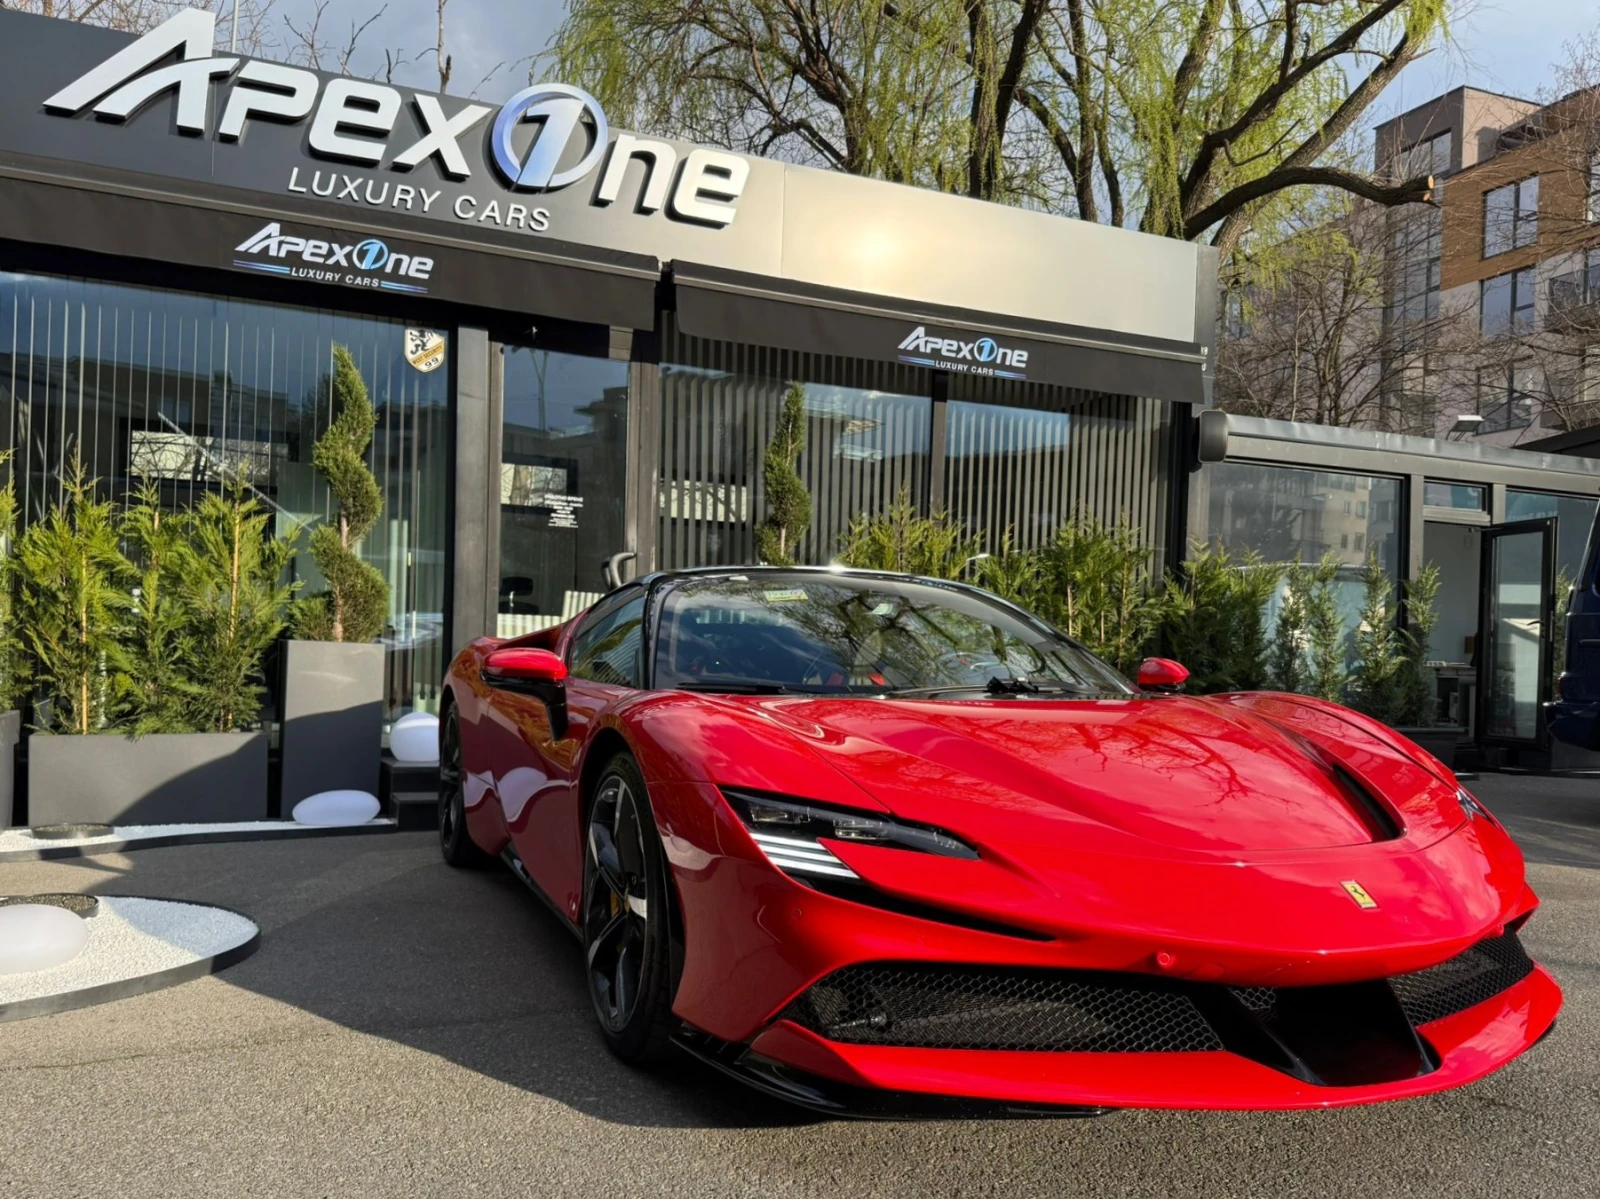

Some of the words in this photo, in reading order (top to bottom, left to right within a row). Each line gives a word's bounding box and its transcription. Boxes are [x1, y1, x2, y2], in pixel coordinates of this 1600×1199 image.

[288, 167, 441, 214] LUXURY
[453, 195, 551, 233] CARS
[291, 266, 342, 282] LUXURY
[345, 274, 380, 288] CARS
[935, 360, 969, 372] LUXURY
[971, 365, 994, 376] CARS
